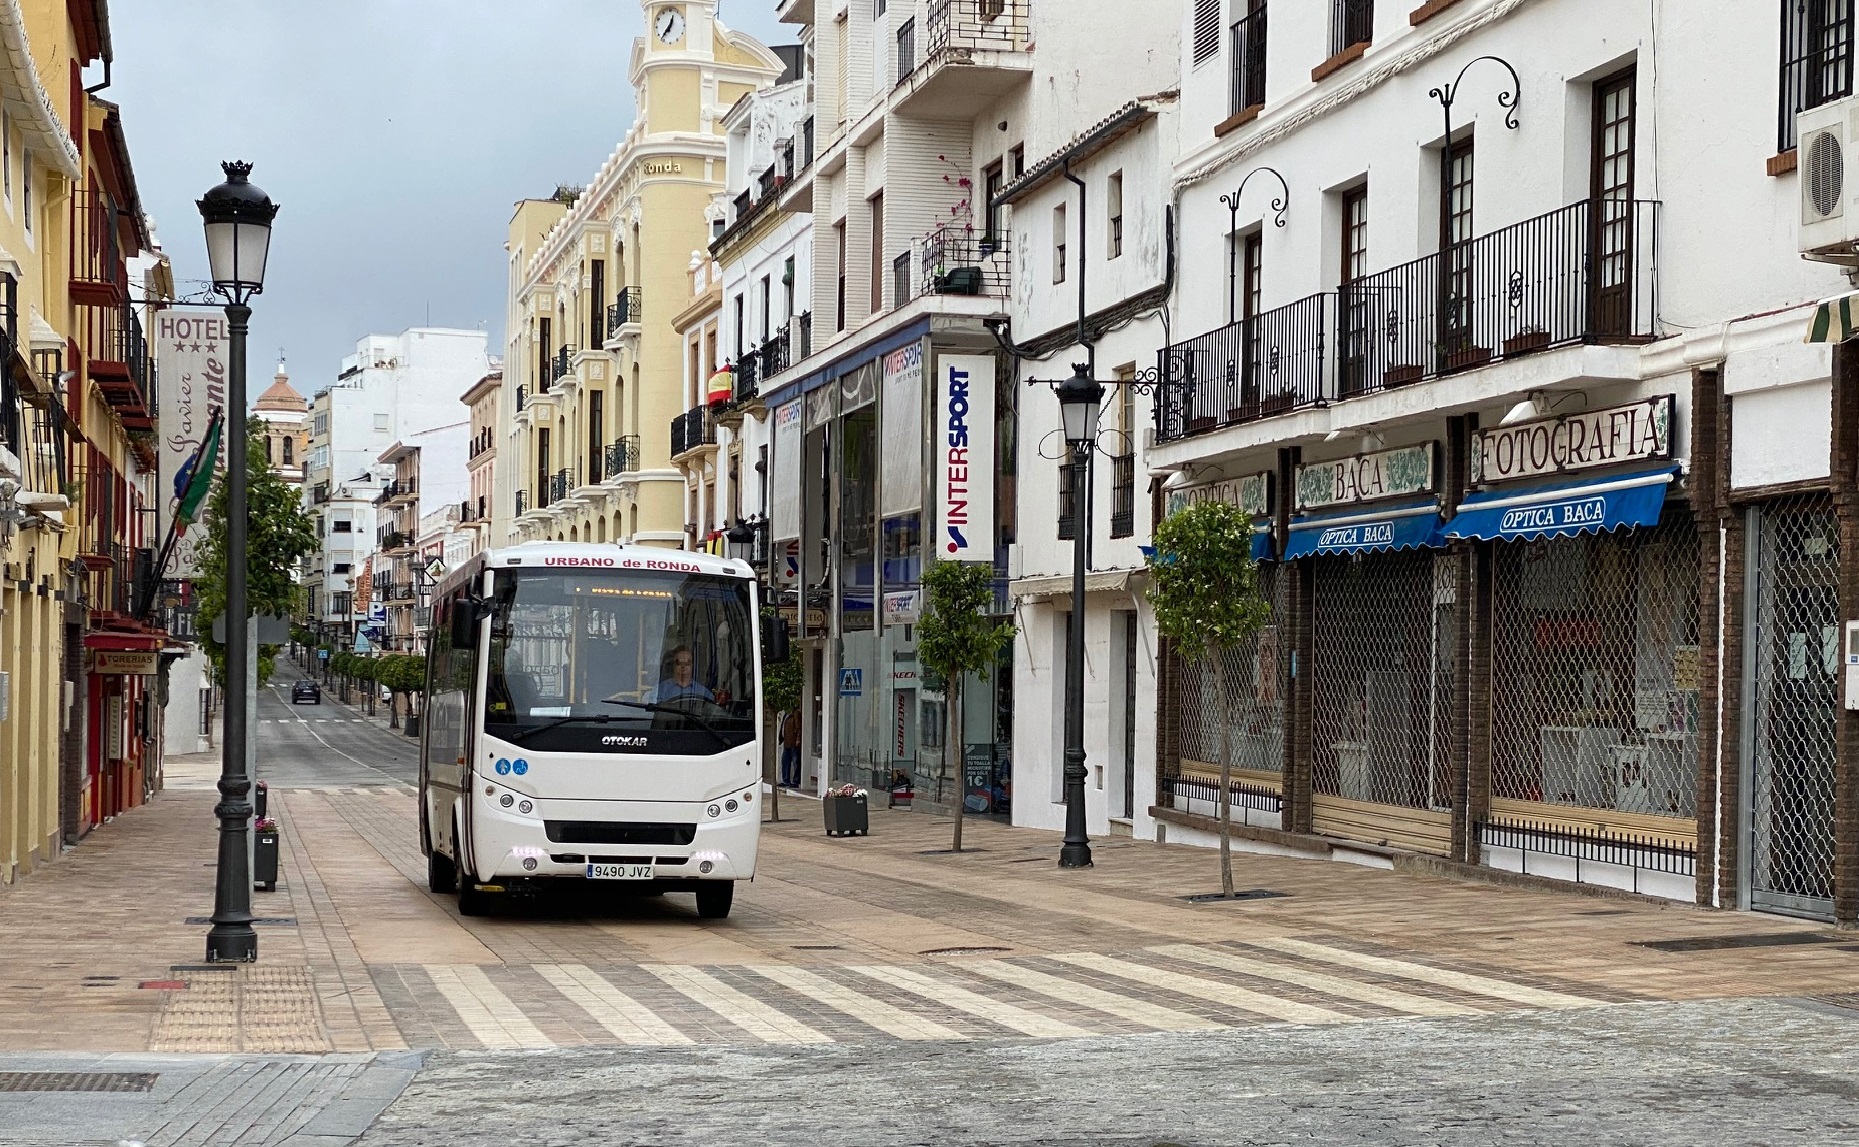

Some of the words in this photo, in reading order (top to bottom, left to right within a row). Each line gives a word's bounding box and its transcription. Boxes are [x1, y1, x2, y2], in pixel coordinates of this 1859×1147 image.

[161, 317, 230, 340] HOTEL
[166, 372, 200, 453] Javier
[947, 366, 969, 525] INTERSPORT
[1480, 406, 1663, 481] FOTOGRAFIA
[1335, 457, 1384, 501] BACA
[1503, 508, 1555, 529] OPTICA
[1563, 501, 1604, 522] BACA
[1320, 528, 1357, 545] OPTICA
[1363, 524, 1392, 543] BACA
[544, 557, 615, 567] URBANO
[622, 558, 641, 568] de
[646, 560, 702, 573] RONDA
[897, 694, 905, 757] SKECHERS
[601, 736, 648, 747] OTOKAR
[967, 776, 984, 787] 1€
[595, 867, 625, 878] 9490
[629, 867, 651, 878] JVZ
